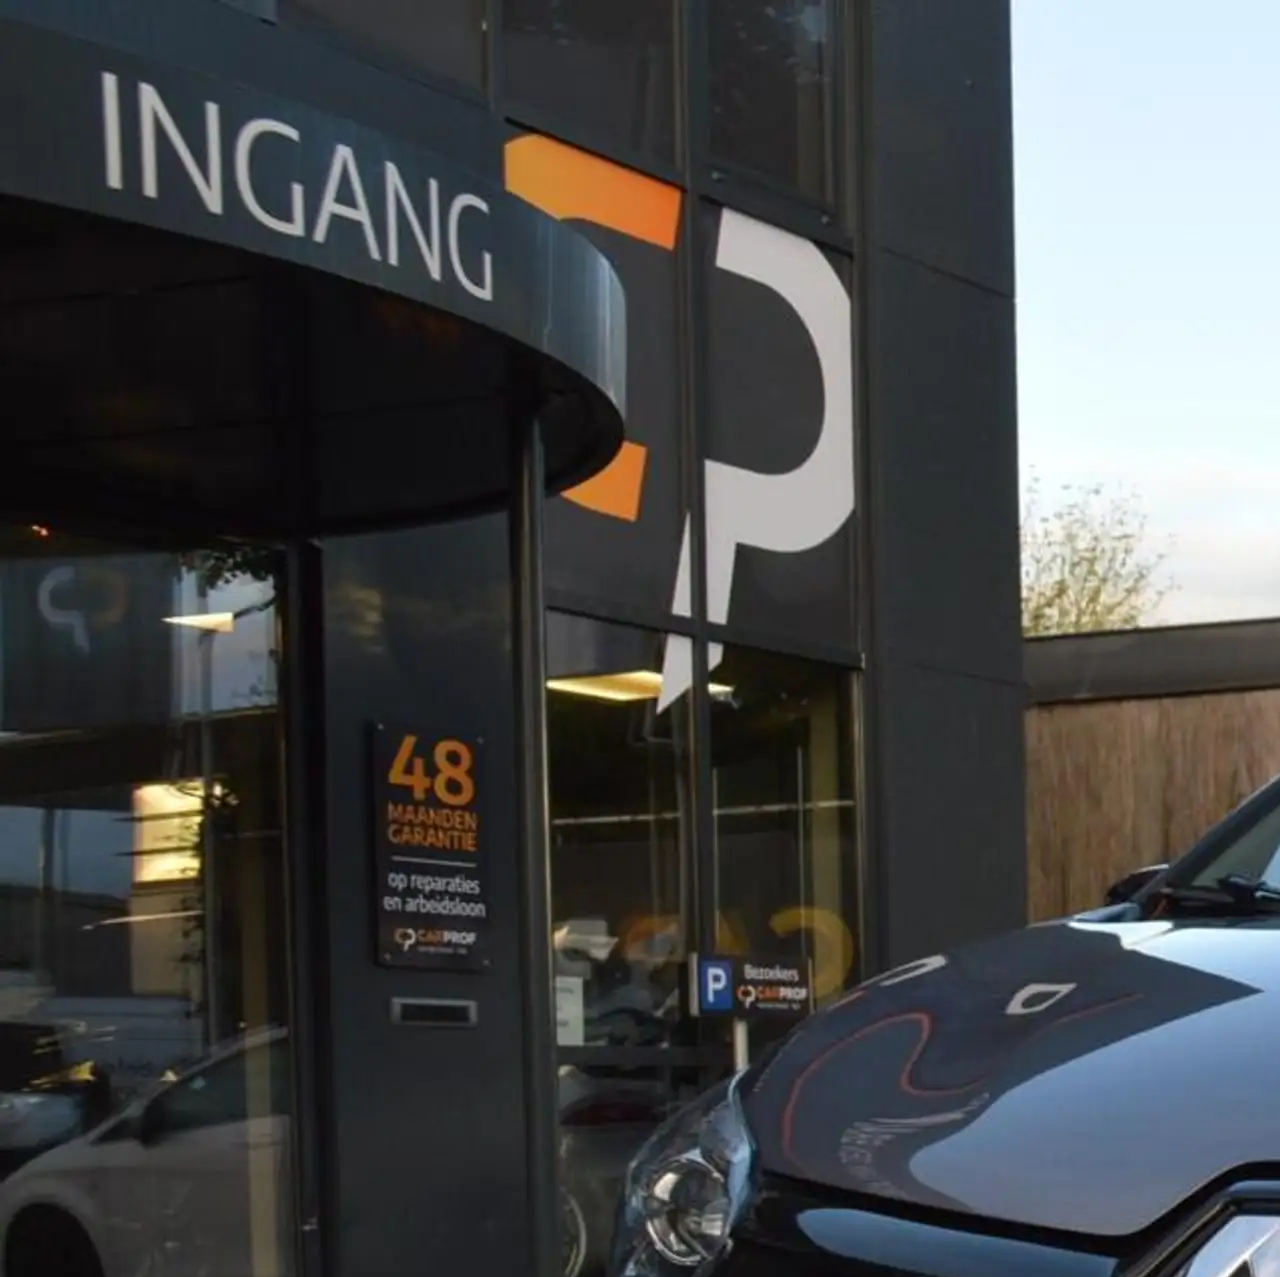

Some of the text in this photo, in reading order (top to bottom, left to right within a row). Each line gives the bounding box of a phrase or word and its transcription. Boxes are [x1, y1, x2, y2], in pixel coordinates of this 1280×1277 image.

[101, 71, 493, 302] INGANG
[388, 734, 475, 806] 48
[387, 800, 478, 832] MAANDEN
[387, 822, 478, 853] GARANTIE
[387, 872, 481, 895] op reparaties
[383, 894, 486, 918] en arbeidsloon
[707, 966, 728, 1004] P
[743, 964, 801, 982] Bezoekers
